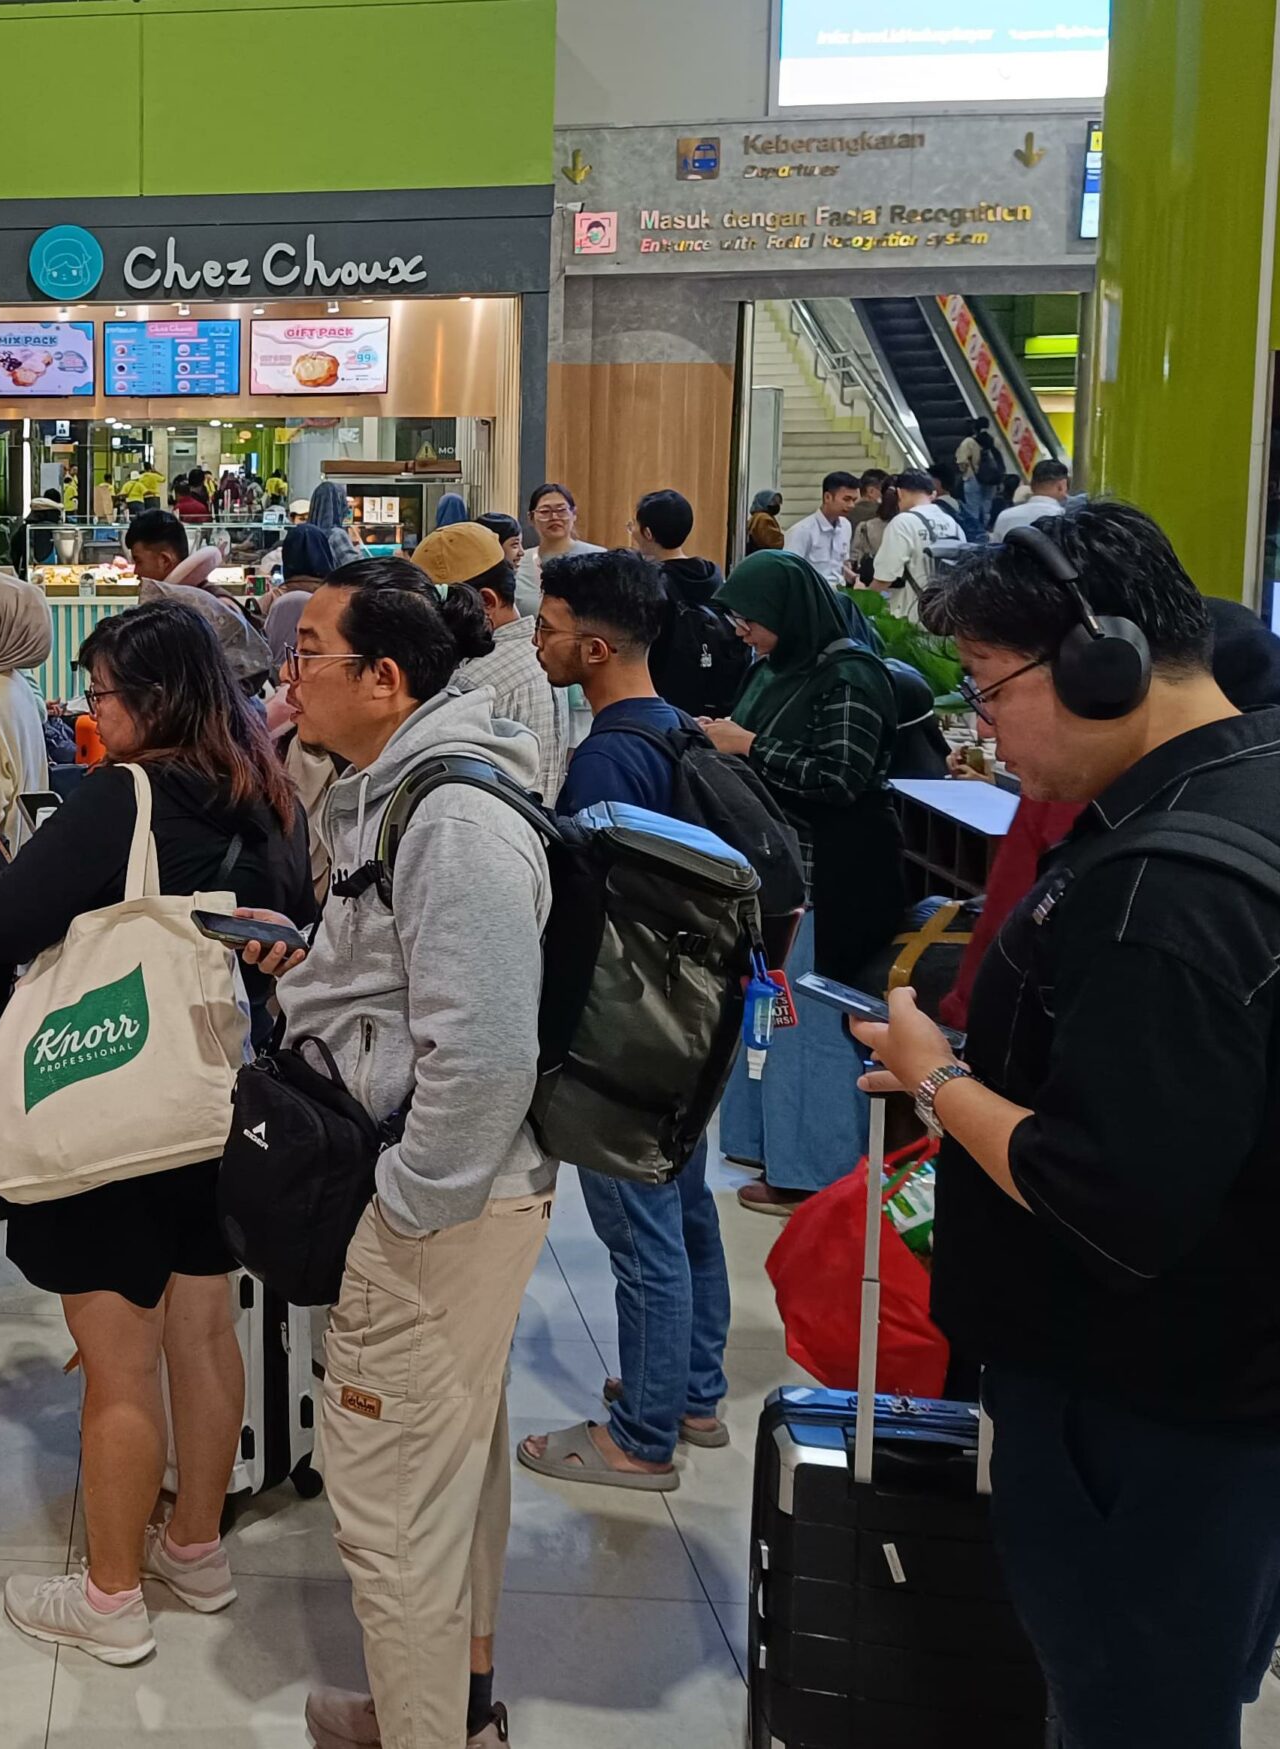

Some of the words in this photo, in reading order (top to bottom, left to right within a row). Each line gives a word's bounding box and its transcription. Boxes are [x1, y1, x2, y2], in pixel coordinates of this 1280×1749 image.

[744, 131, 926, 157] Keberangkatan
[640, 208, 713, 230] Masuk
[723, 208, 808, 232] dengan
[123, 236, 252, 290] Chez
[262, 233, 427, 287] Choux
[24, 335, 58, 345] PACK
[319, 327, 354, 336] PACK
[33, 1013, 141, 1066] Knorr
[39, 1042, 134, 1075] PROFESSIONAL
